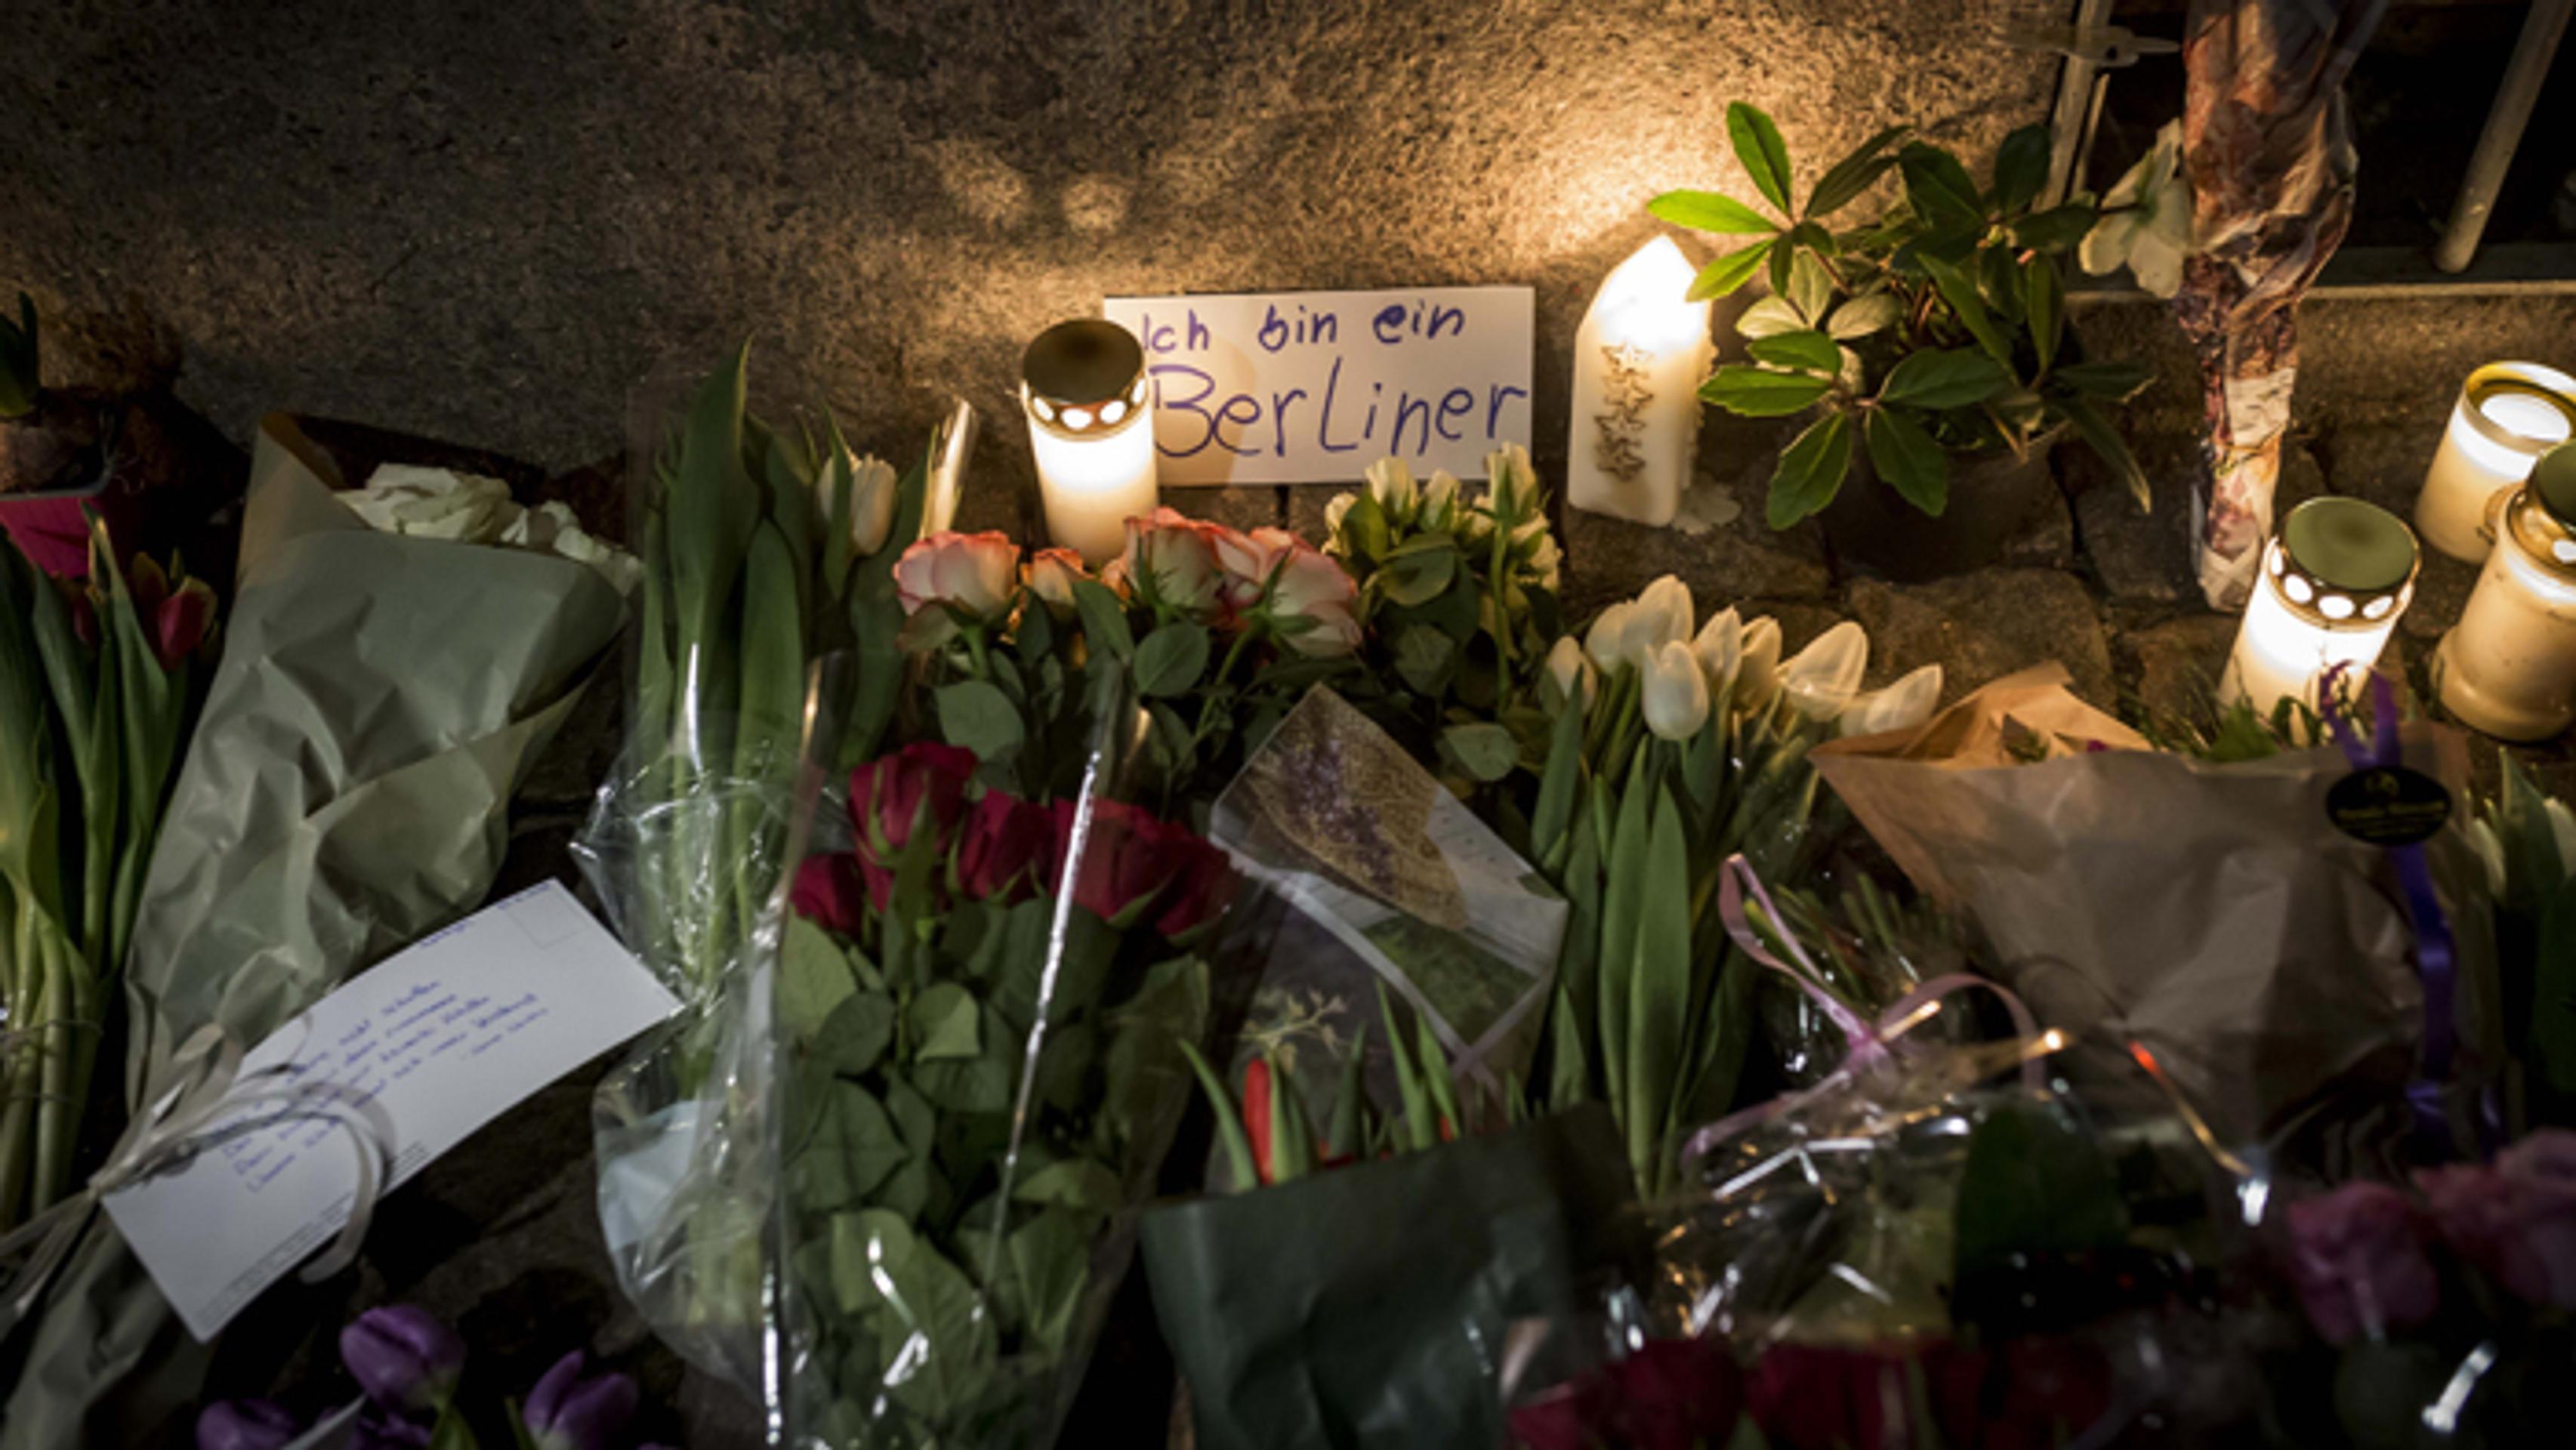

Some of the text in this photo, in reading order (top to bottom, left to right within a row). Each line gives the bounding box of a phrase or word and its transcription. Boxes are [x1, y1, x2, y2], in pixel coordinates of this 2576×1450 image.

[1142, 300, 1466, 353] Ich bin ein
